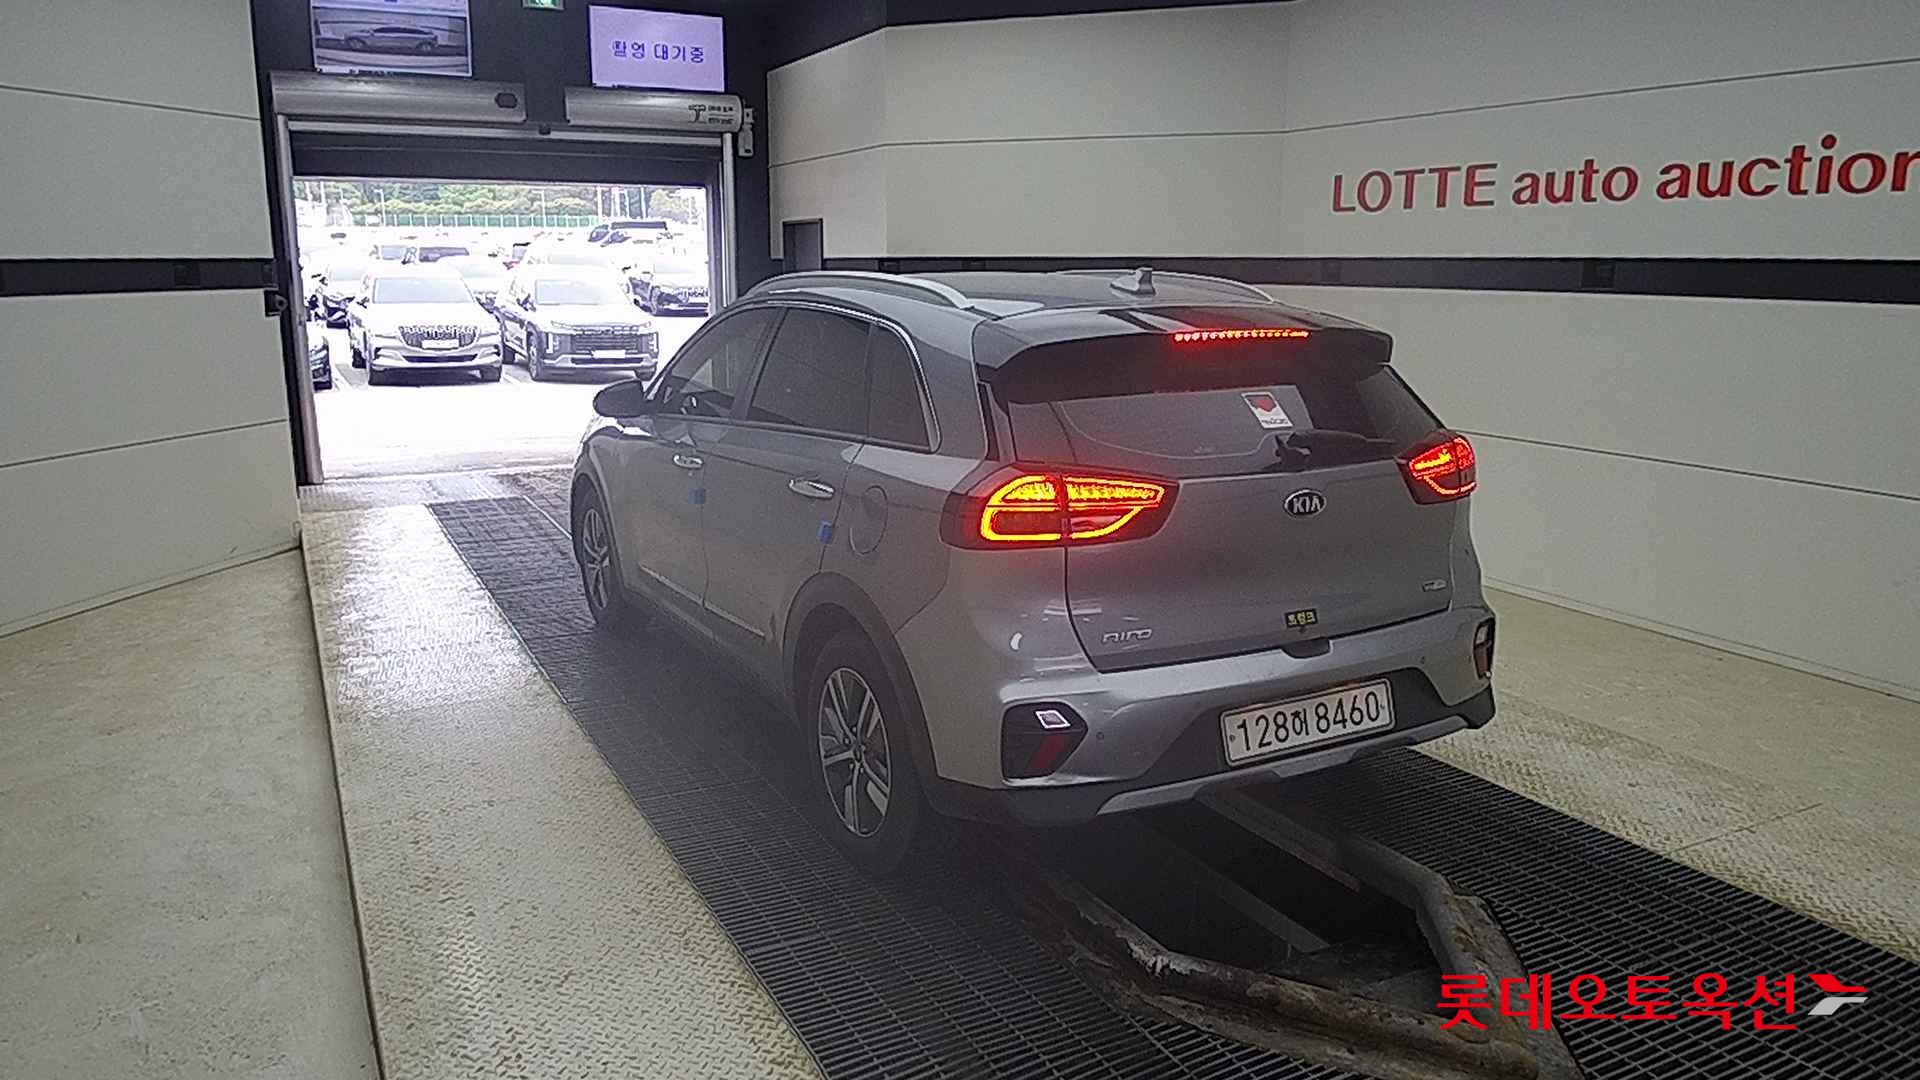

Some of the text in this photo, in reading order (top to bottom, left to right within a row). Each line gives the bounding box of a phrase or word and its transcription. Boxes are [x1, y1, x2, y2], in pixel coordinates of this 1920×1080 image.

[654, 43, 704, 64] 대기중
[1332, 163, 1498, 213] LOTTE
[1512, 159, 1640, 206] auto
[1293, 495, 1321, 513] KIA
